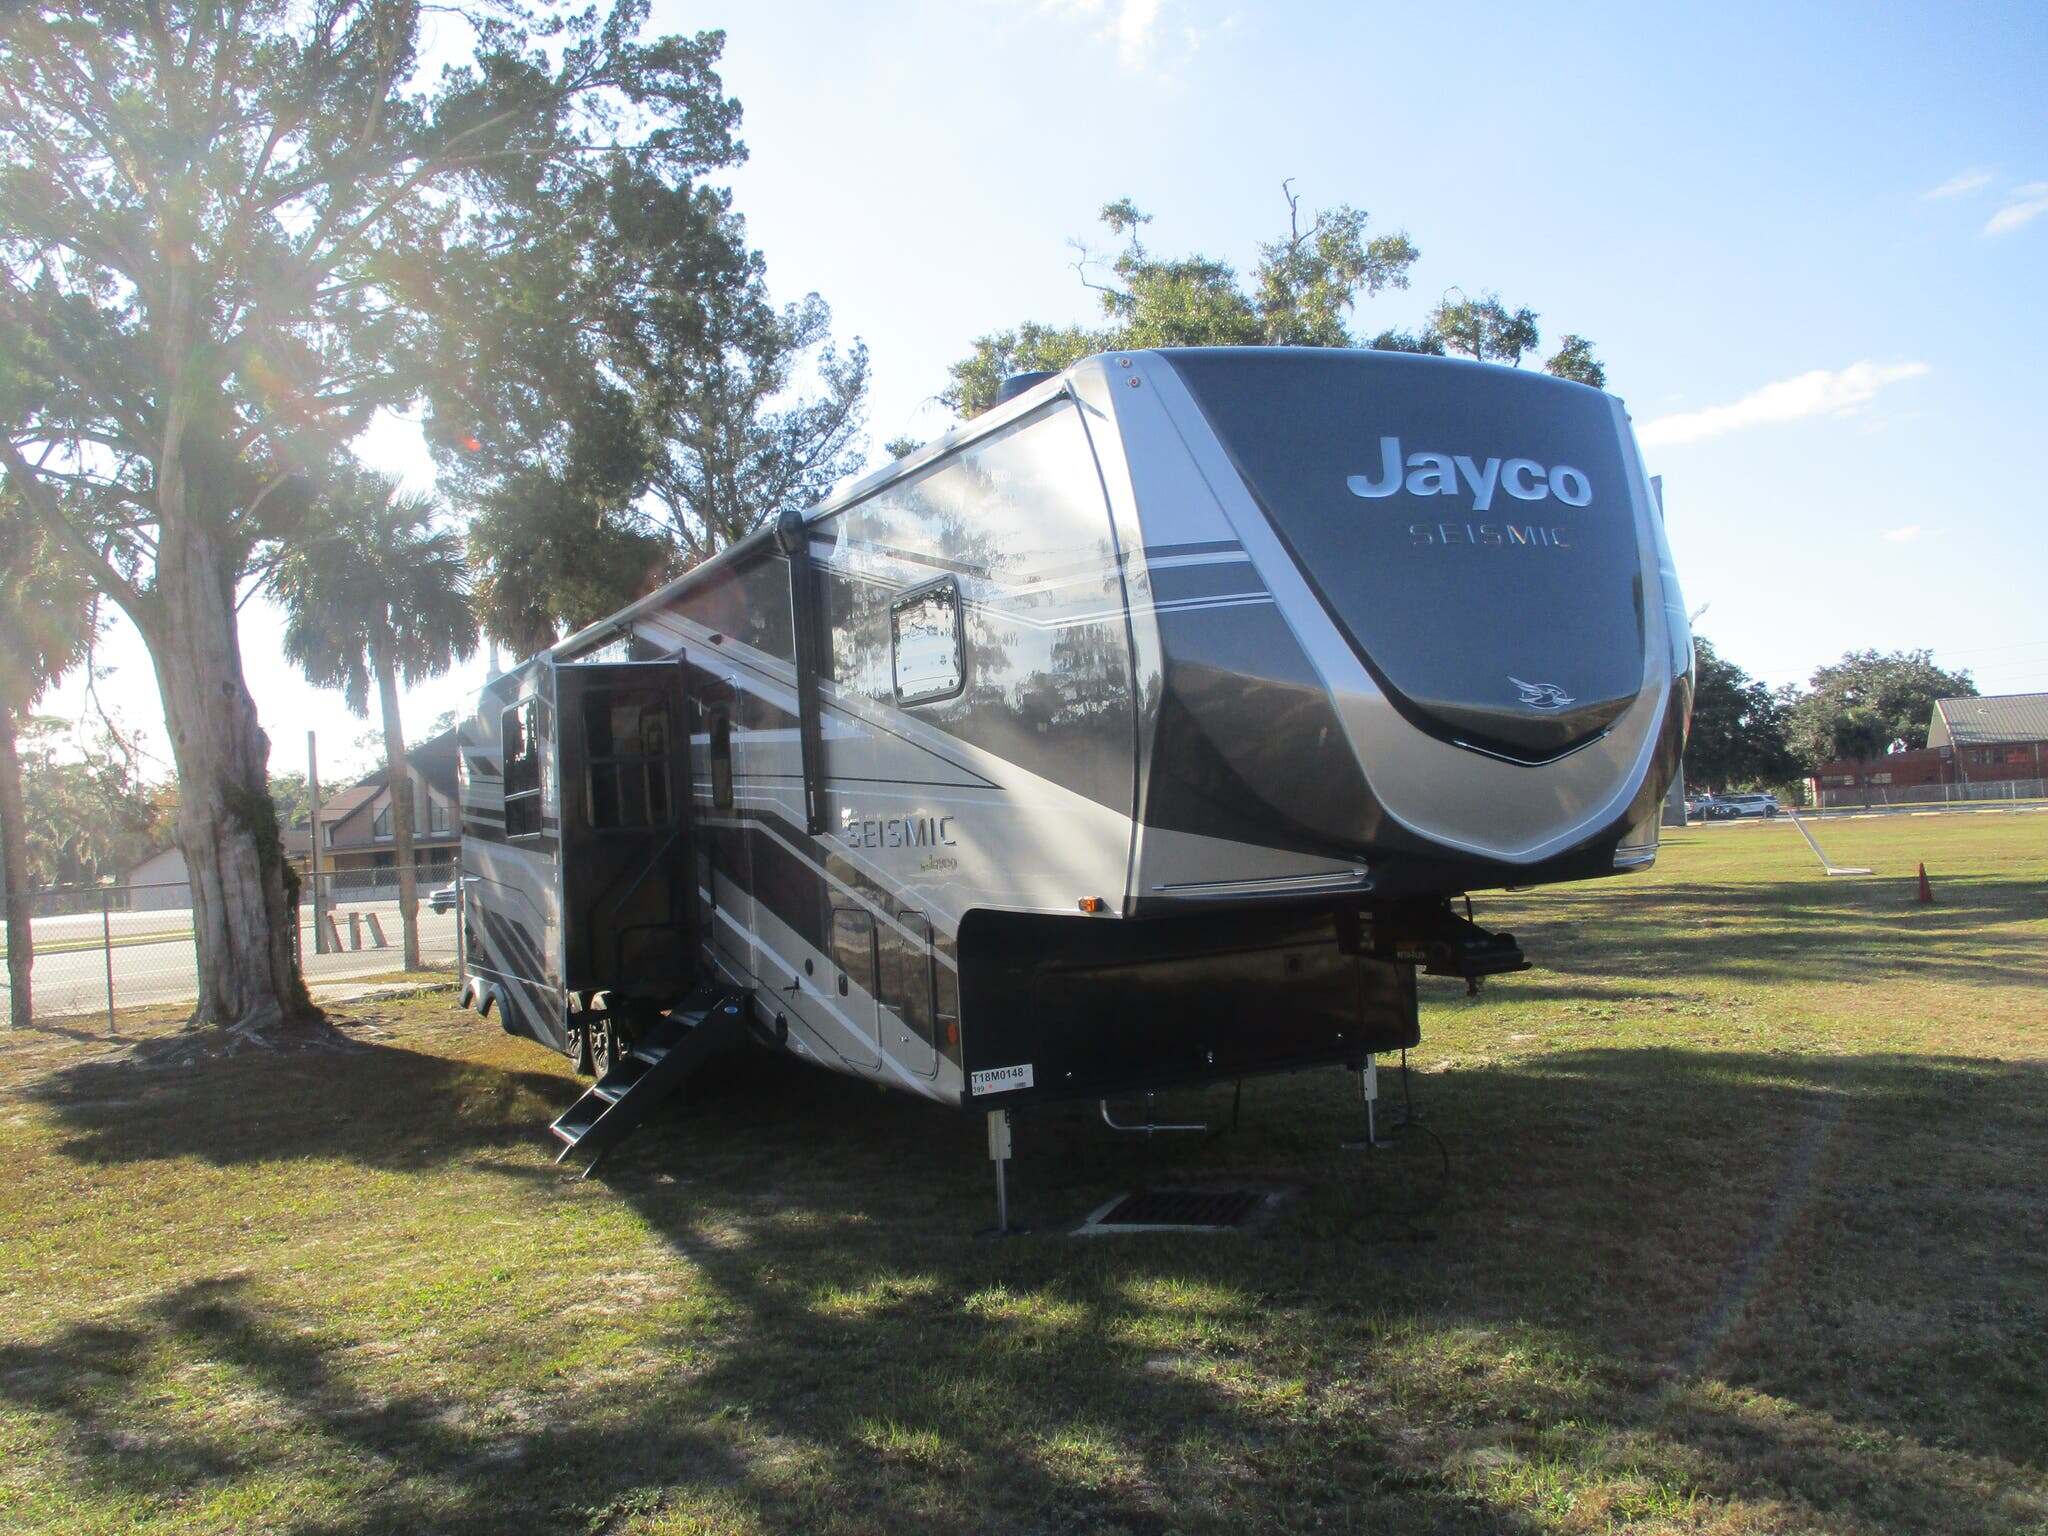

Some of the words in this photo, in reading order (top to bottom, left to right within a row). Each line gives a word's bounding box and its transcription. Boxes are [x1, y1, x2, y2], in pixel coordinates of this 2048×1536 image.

[1347, 436, 1593, 511] Jayco
[1409, 523, 1572, 547] SEISMIC
[847, 816, 956, 848] SEISMIC
[972, 1067, 1024, 1083] T18M0148
